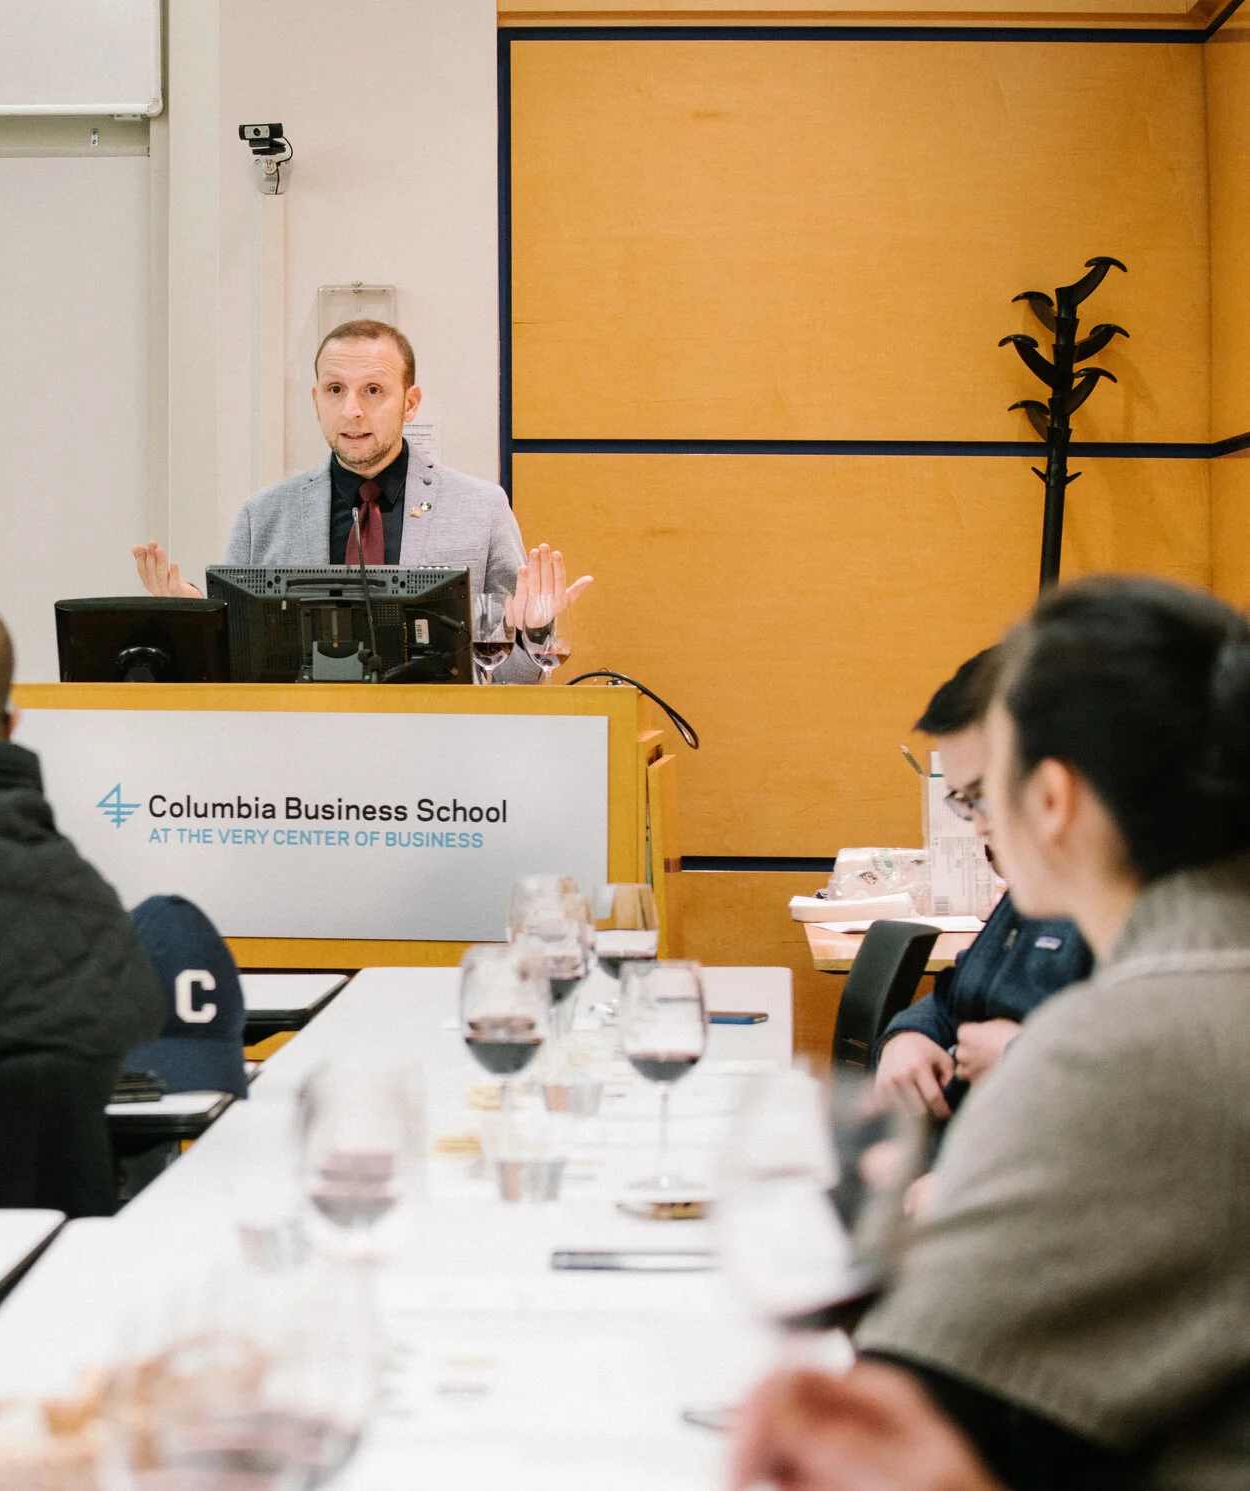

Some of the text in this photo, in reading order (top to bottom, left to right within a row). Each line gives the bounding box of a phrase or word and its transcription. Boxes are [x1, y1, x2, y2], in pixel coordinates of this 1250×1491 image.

[148, 794, 508, 823] Columbia Business School
[149, 827, 484, 848] AT THE VERY CENTER OF BUSINESS
[175, 969, 217, 1023] C
